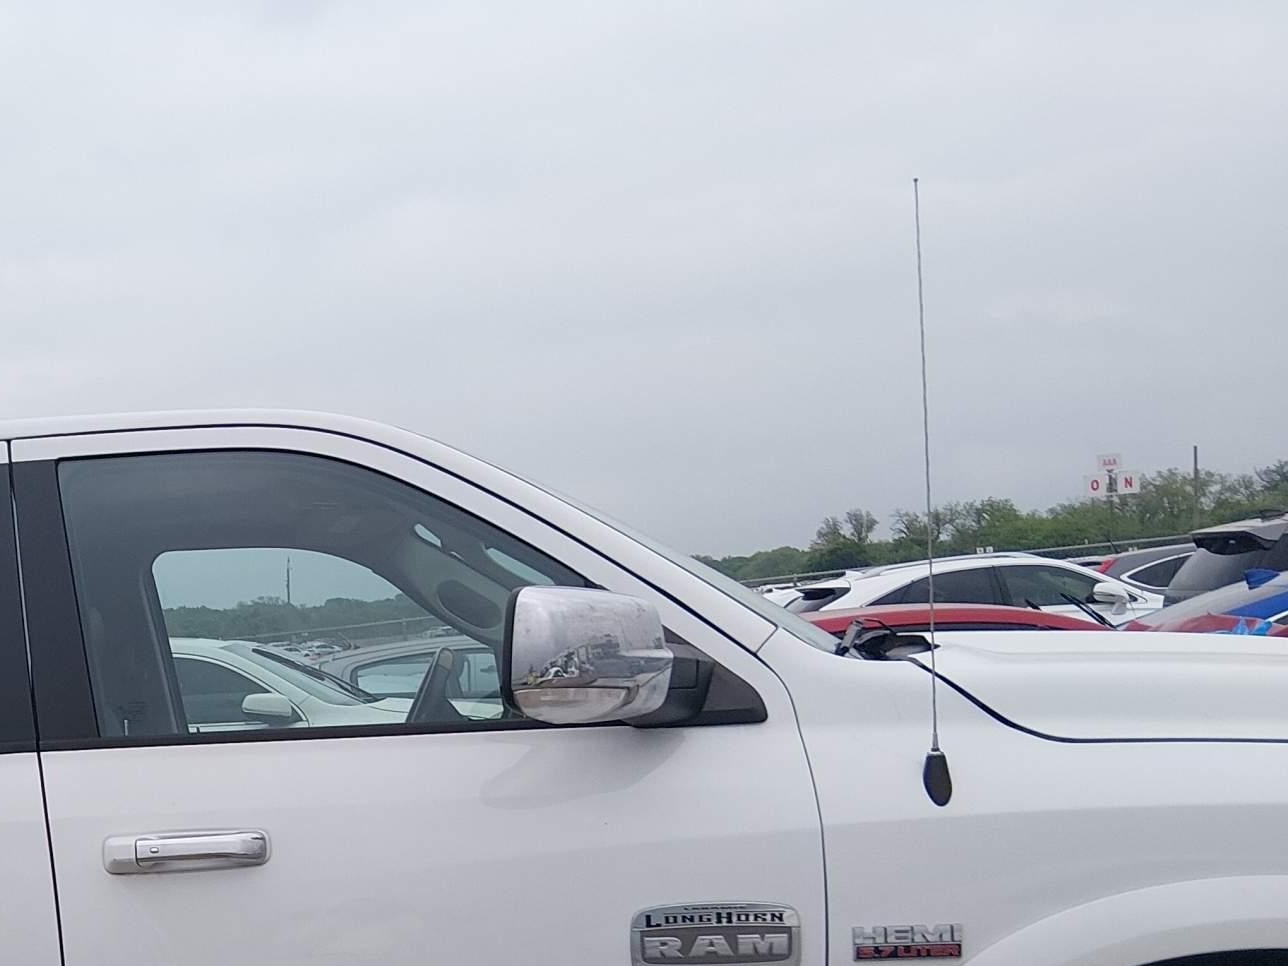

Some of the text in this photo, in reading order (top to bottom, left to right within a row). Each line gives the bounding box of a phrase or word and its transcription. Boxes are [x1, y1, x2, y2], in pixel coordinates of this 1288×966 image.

[1124, 476, 1133, 489] N
[852, 923, 963, 943] HEMI
[643, 933, 789, 959] RAM
